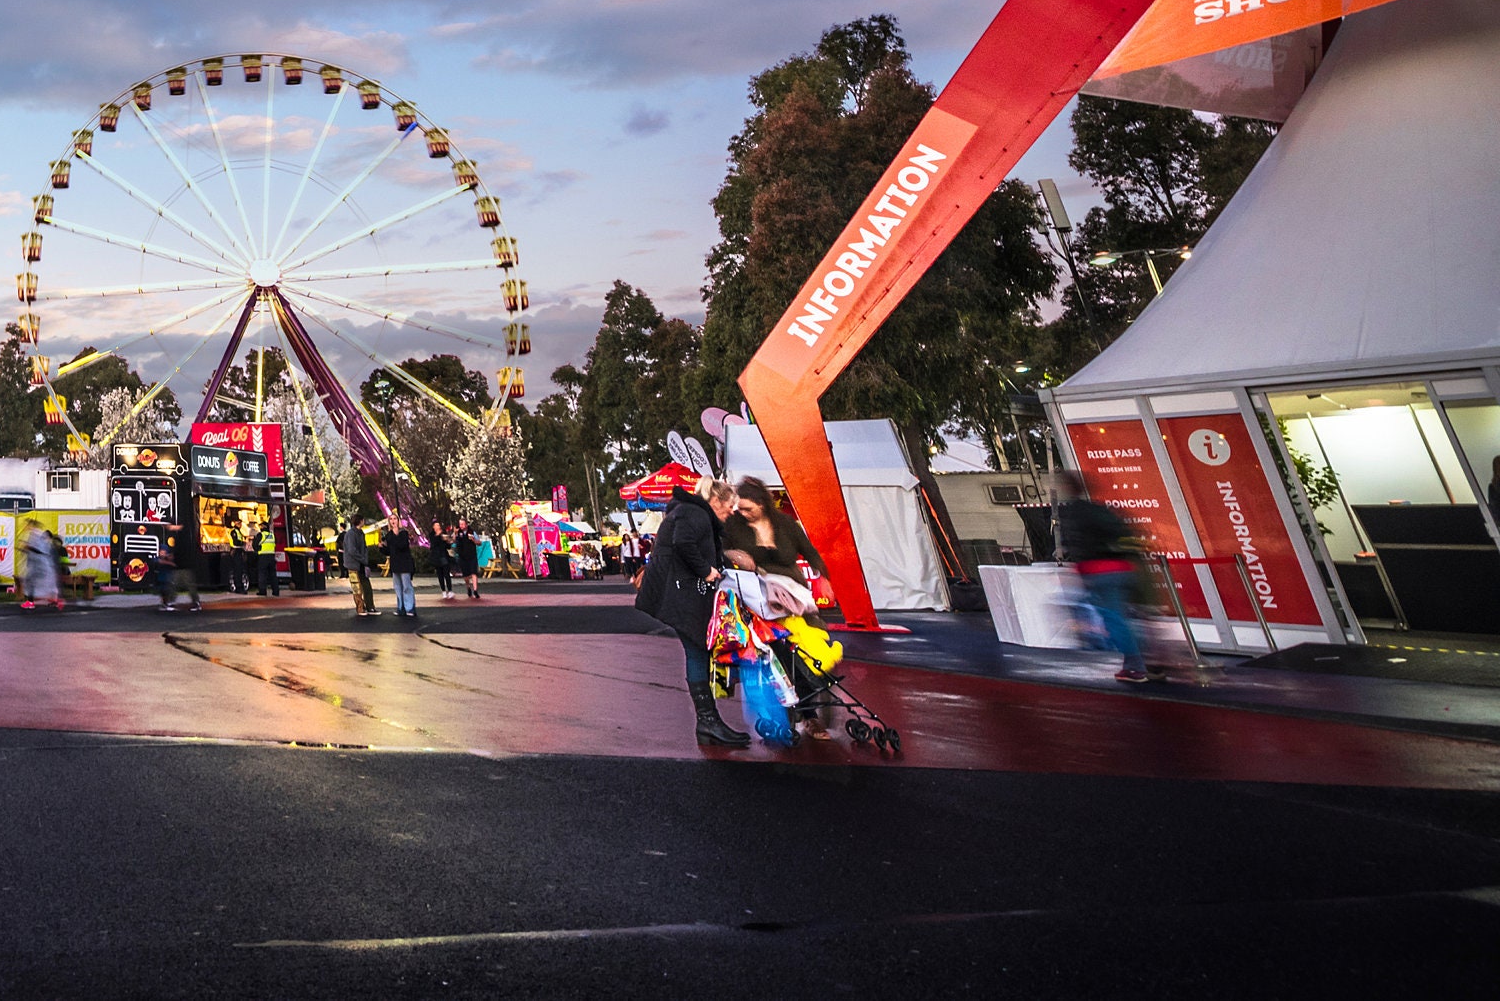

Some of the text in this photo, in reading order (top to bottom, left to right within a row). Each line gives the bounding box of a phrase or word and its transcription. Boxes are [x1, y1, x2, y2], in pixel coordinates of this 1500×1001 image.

[786, 143, 947, 348] INFORMATION
[201, 425, 249, 446] Real OG
[1087, 448, 1142, 459] RIDE PASS
[197, 454, 221, 470] DONUTS
[242, 460, 260, 473] COFFEE
[1105, 499, 1160, 509] PONCHOS
[1133, 516, 1153, 524] EACH
[64, 536, 111, 545] MELBOURN
[1216, 481, 1278, 609] INFORMATION
[66, 544, 111, 560] SHOW
